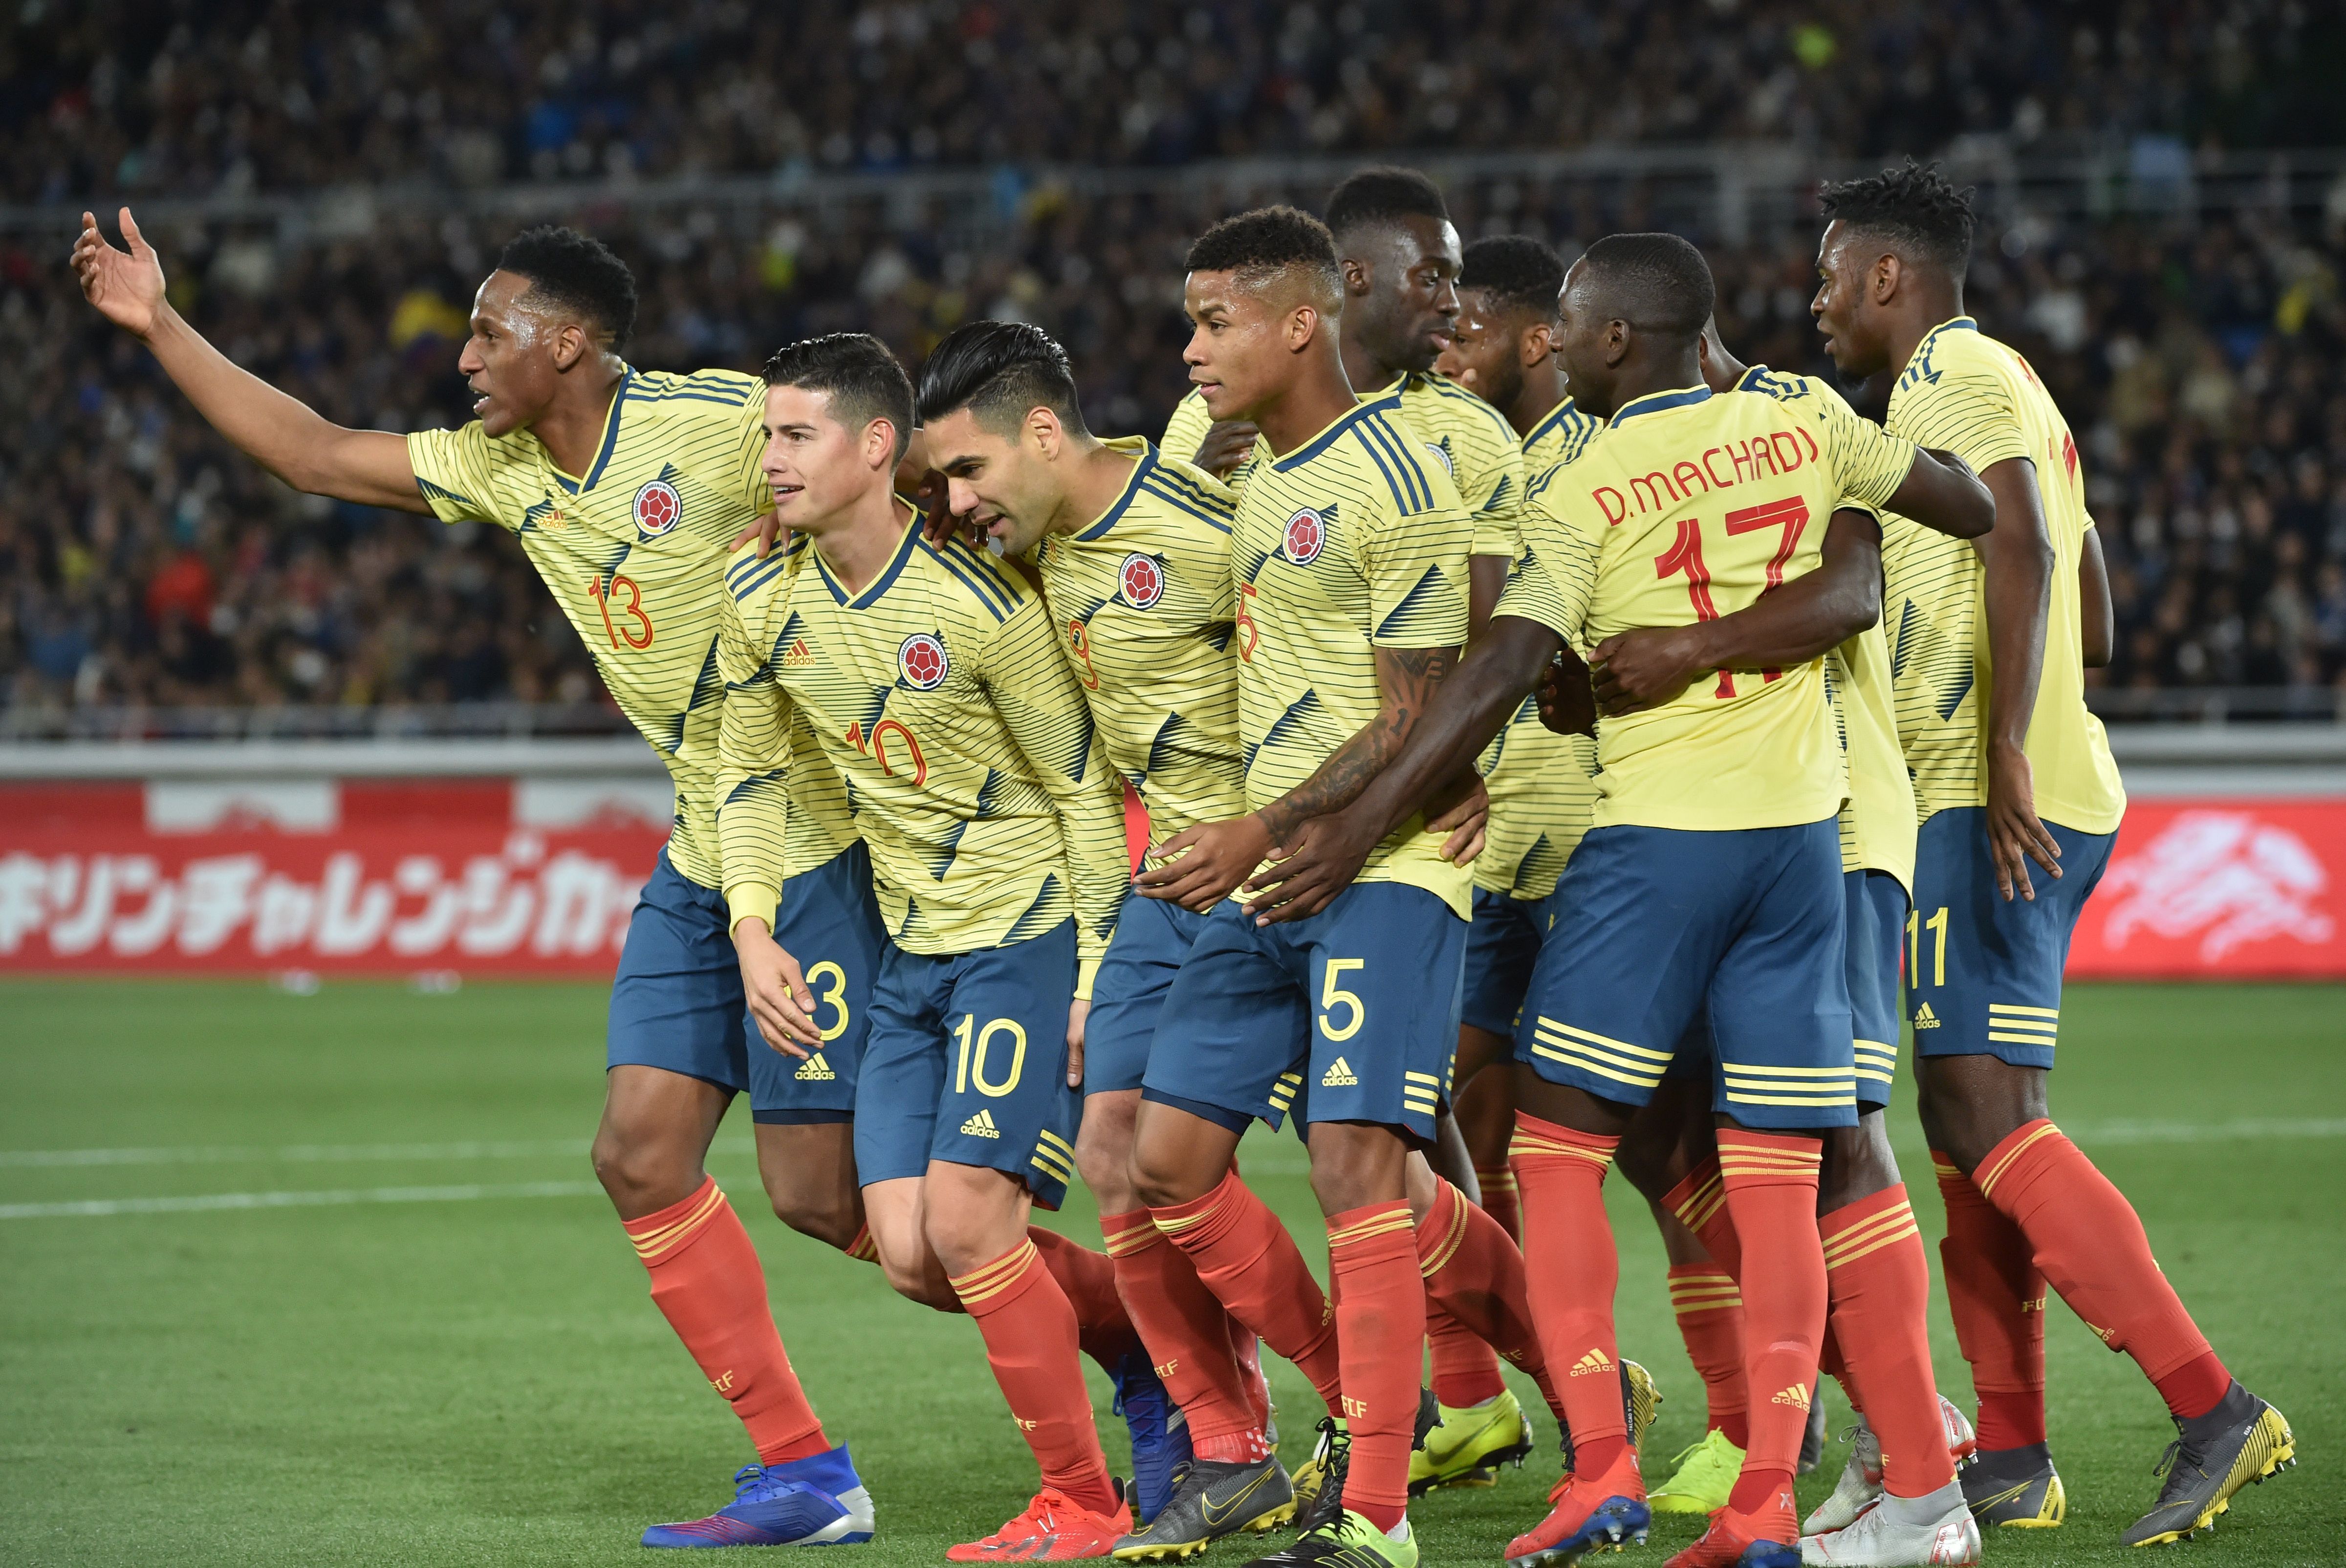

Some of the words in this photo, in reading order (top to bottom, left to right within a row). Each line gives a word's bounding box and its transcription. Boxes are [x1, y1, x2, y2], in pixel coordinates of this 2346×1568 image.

[588, 575, 653, 649] 13
[1237, 581, 1258, 664] 5
[1654, 495, 1810, 699] 17
[783, 655, 815, 665] adidas
[1069, 620, 1099, 690] 9
[845, 719, 927, 787] 10
[1906, 907, 1949, 989] 11
[783, 961, 849, 1041] 3
[1319, 958, 1365, 1042] 5
[1914, 1019, 1941, 1029] didas
[794, 1069, 835, 1080] adidas
[954, 1014, 1026, 1097] 10
[1322, 1075, 1358, 1087] adidas
[960, 1125, 1000, 1139] adidas
[1570, 1363, 1616, 1377] adidas
[1341, 1394, 1367, 1419] FCF
